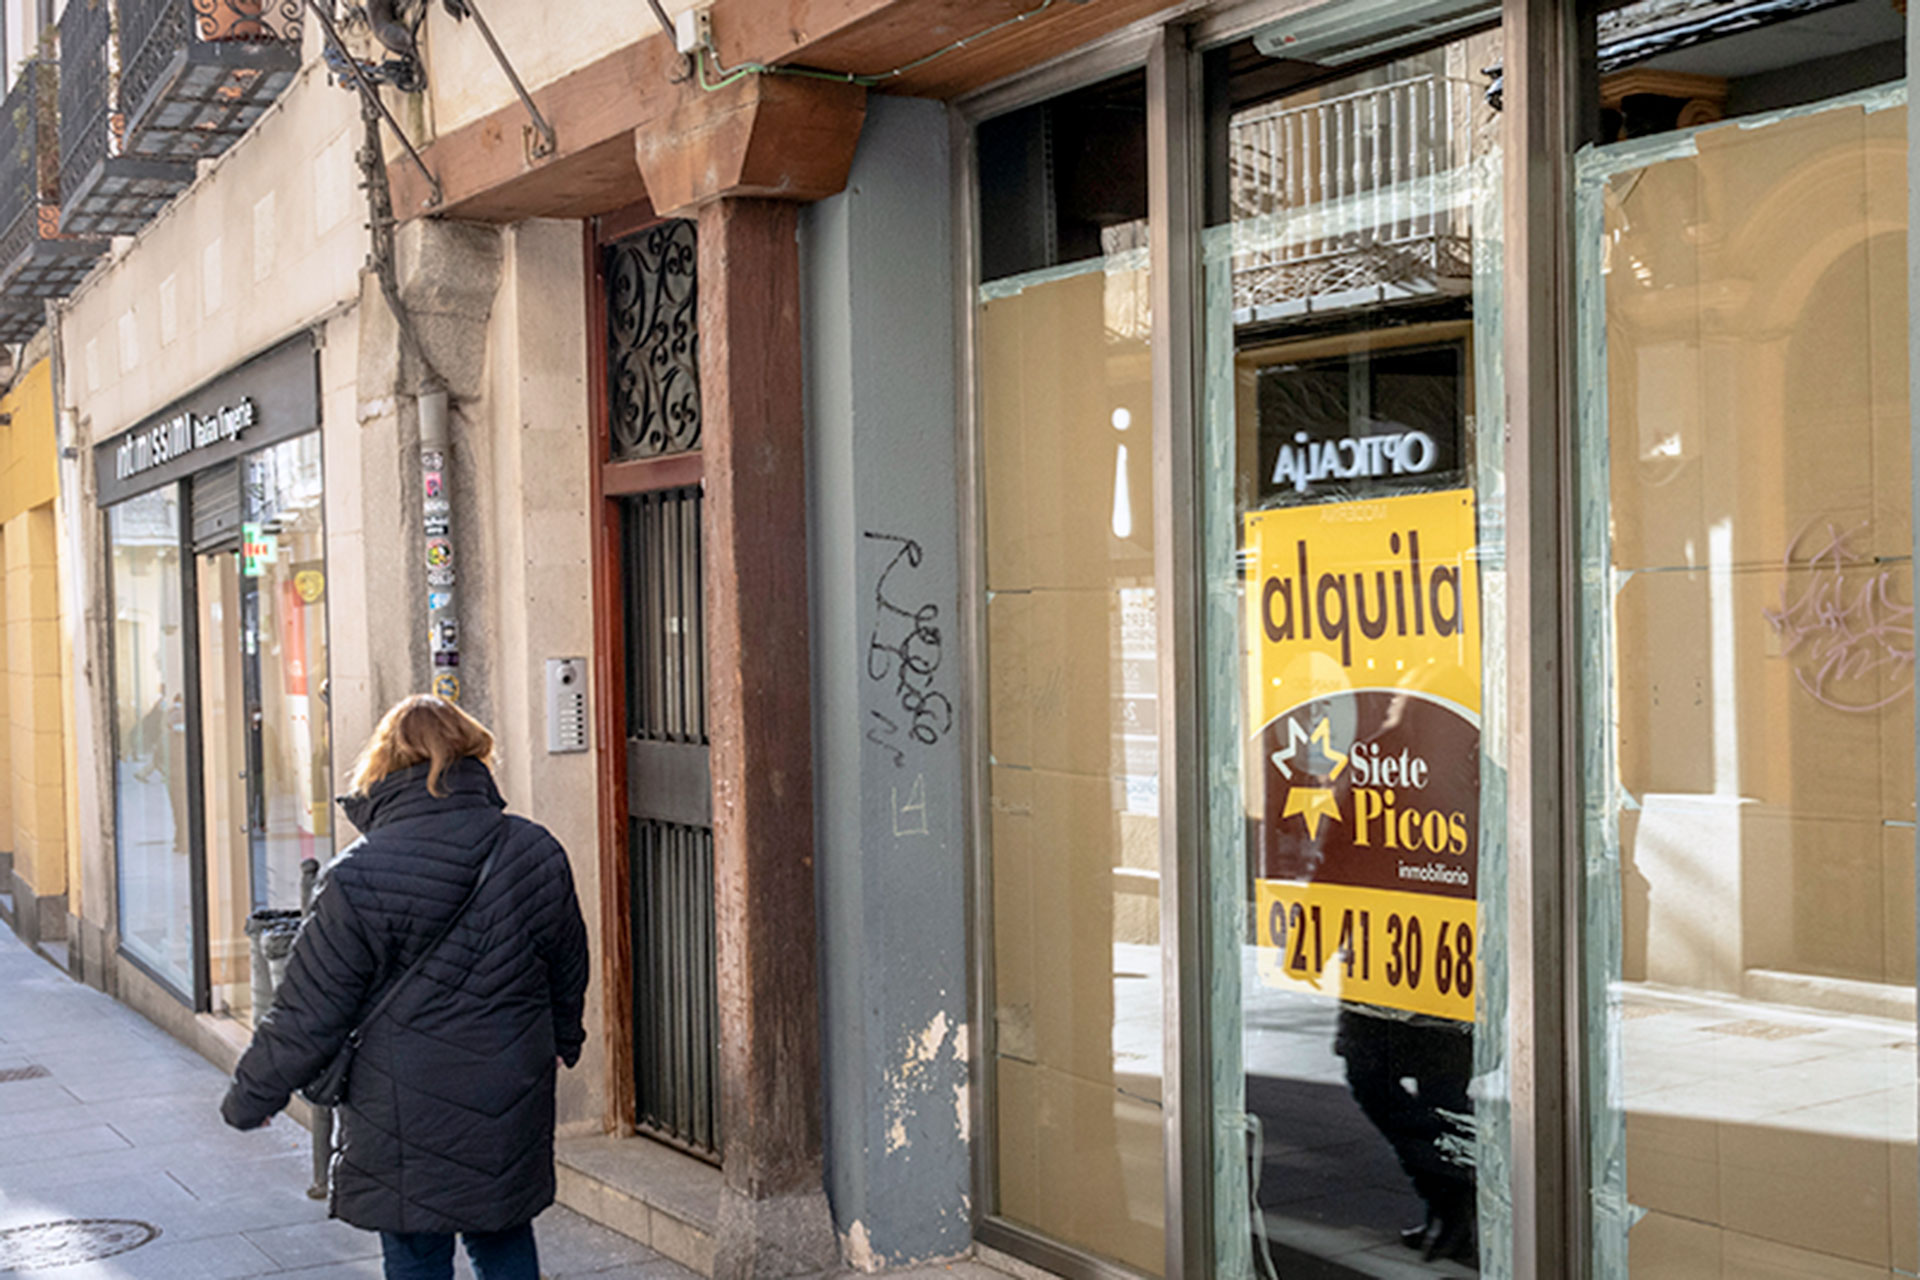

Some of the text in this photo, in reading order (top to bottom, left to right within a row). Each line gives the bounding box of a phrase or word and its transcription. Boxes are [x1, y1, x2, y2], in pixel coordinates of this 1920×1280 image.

[1262, 529, 1465, 667] alquila
[1350, 741, 1428, 788] Siete
[1352, 788, 1468, 855] Picos
[1398, 860, 1469, 886] inmobiliaria
[1268, 900, 1475, 999] 921 41 30 68
